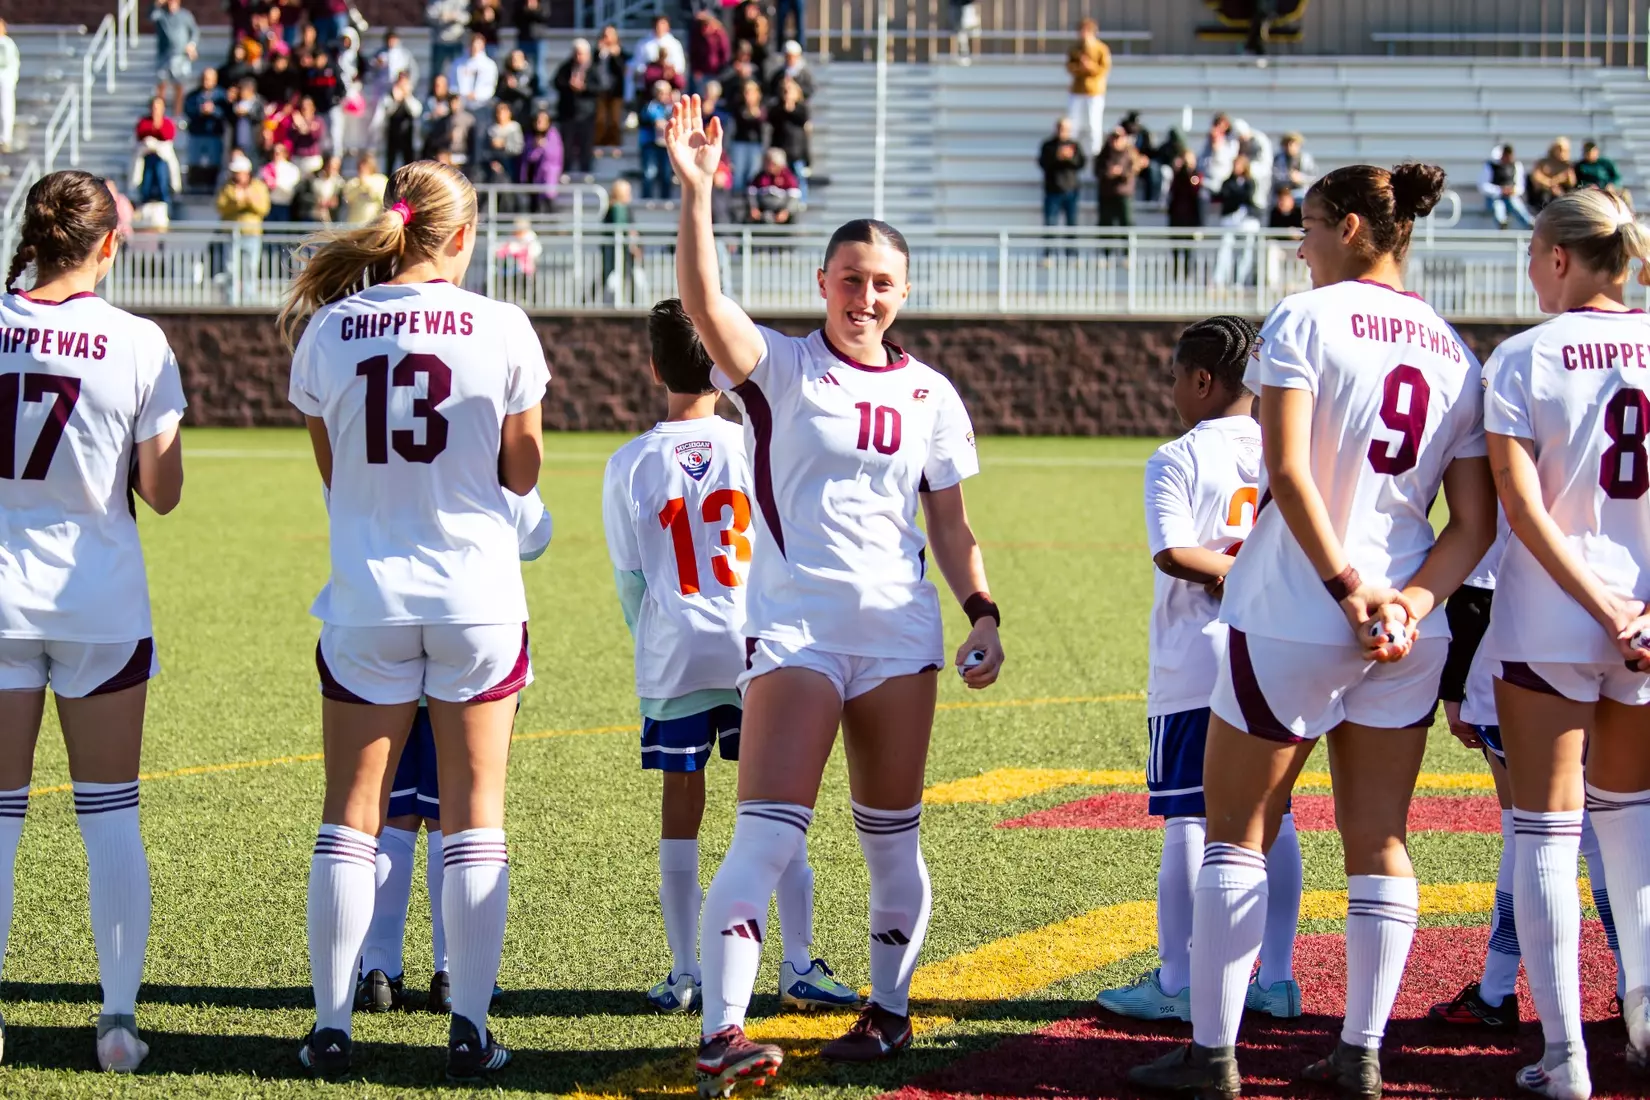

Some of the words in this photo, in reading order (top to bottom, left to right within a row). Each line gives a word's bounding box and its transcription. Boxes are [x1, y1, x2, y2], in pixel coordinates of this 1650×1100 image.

[341, 310, 473, 341] CHIPPEWAS
[1351, 313, 1461, 363] CHIPPEWAS
[1562, 343, 1650, 371] CHIPPE
[0, 372, 81, 480] 17
[356, 353, 452, 464] 13
[855, 401, 901, 456] 10
[1367, 364, 1430, 476] 9
[1600, 388, 1650, 500] 8
[658, 488, 752, 596] 13
